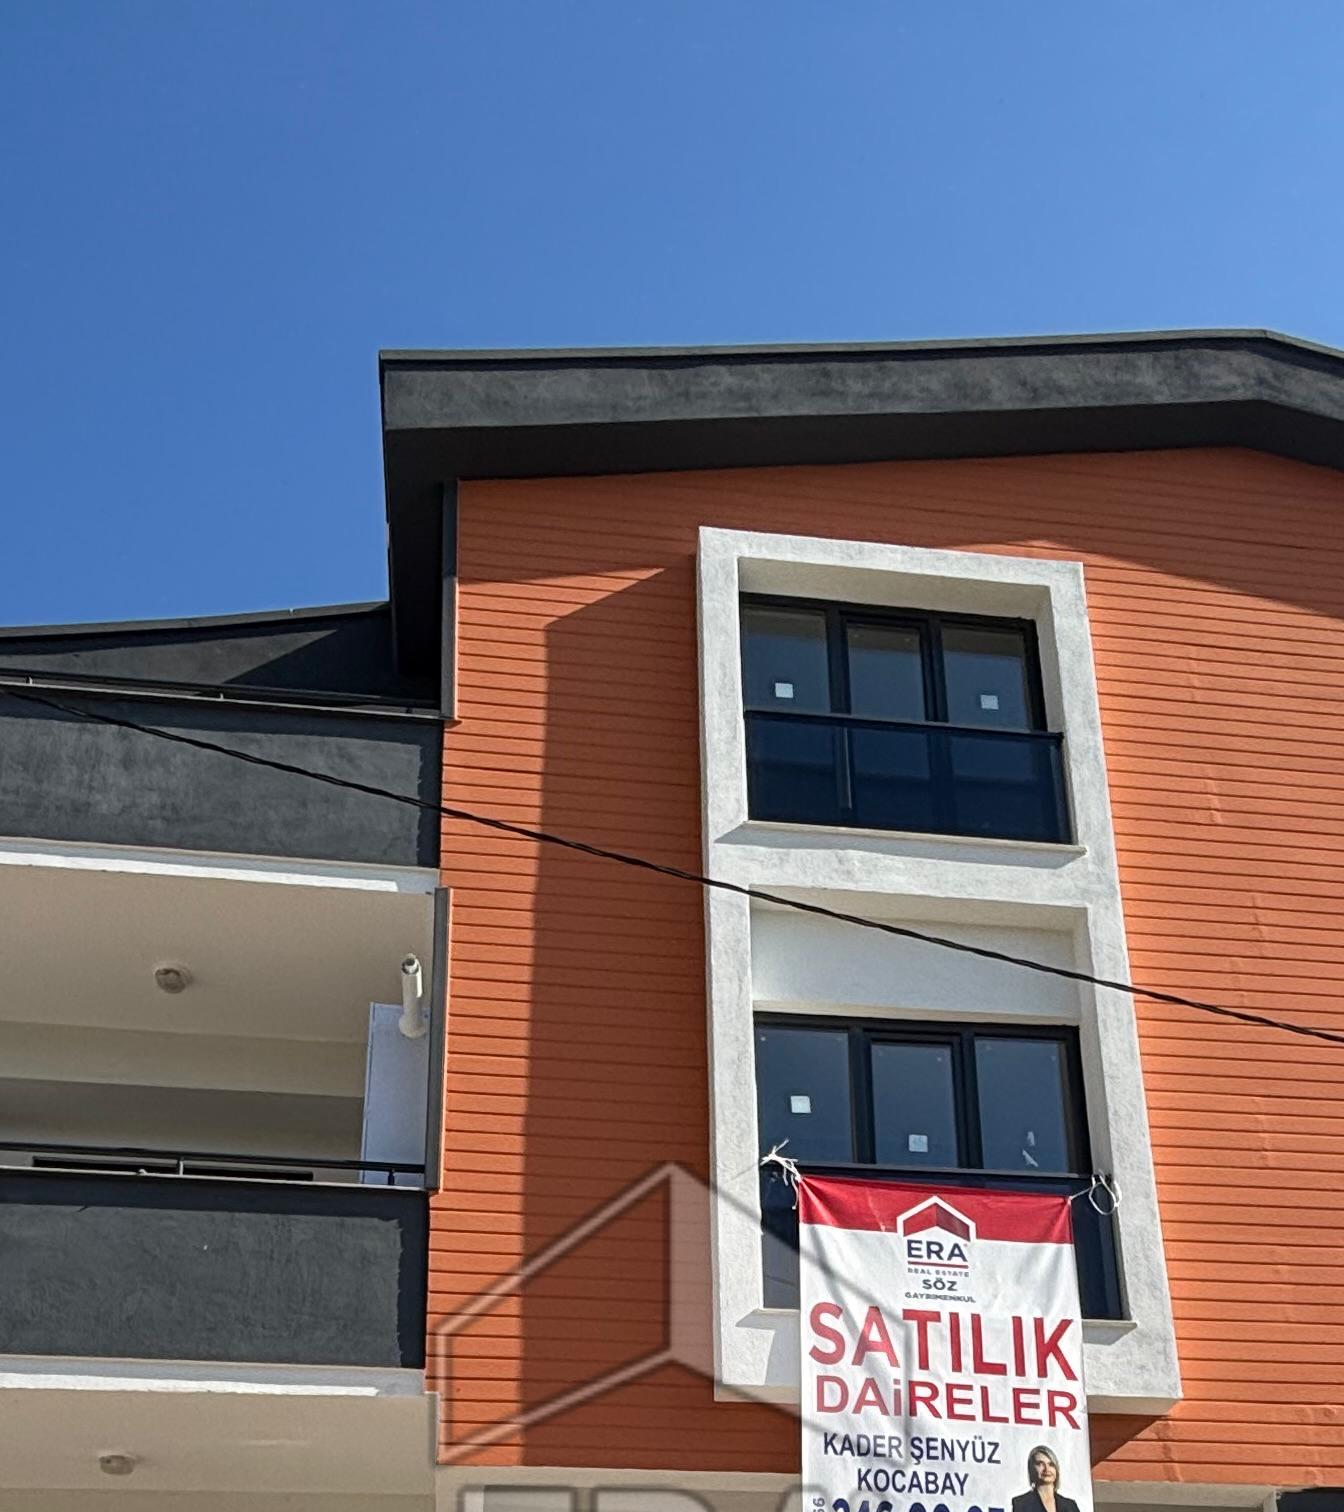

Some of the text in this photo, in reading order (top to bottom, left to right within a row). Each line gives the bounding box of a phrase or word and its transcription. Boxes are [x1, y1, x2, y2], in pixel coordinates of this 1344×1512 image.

[907, 1239, 968, 1262] ERA
[922, 1277, 958, 1291] SÖZ
[935, 1269, 969, 1278] ESTATE
[809, 1302, 1079, 1381] SATILIK
[823, 1432, 1002, 1465] KADER ŞENYÜZ
[857, 1468, 969, 1496] KOCABAY
